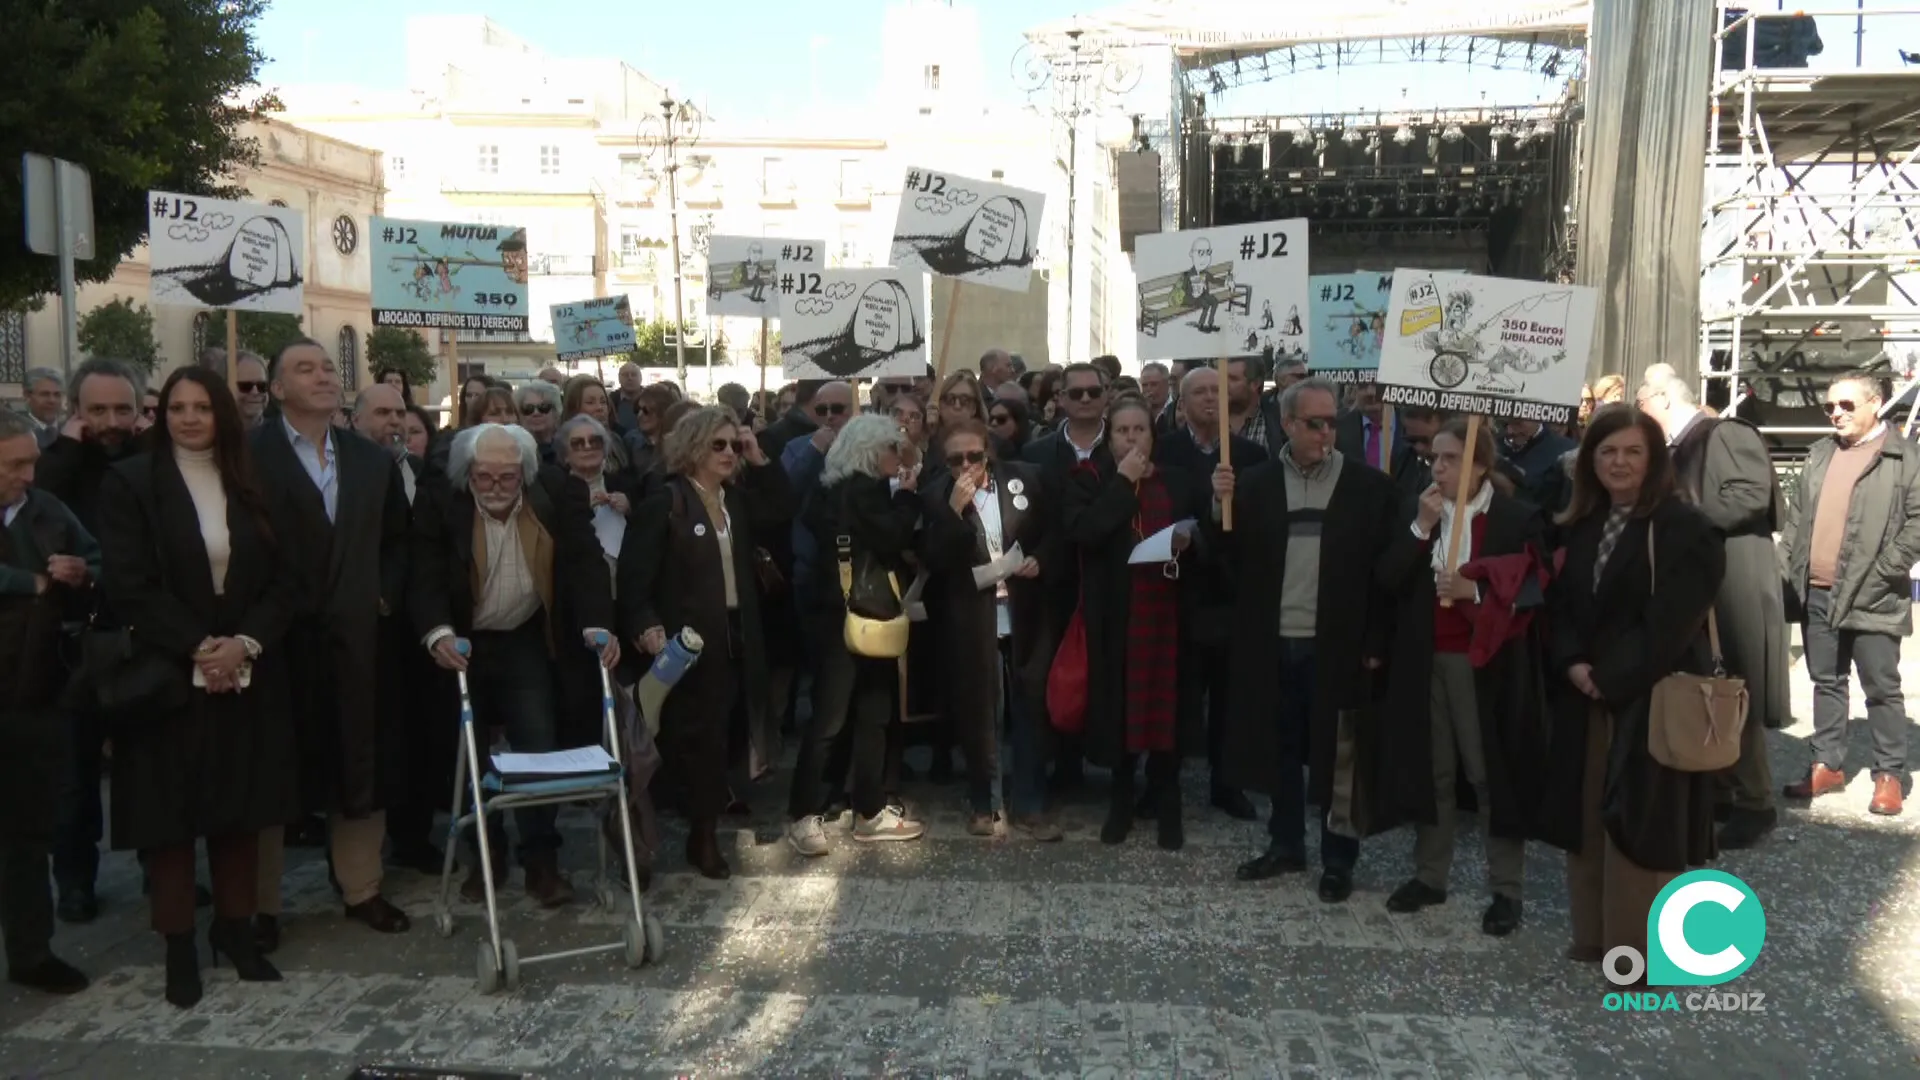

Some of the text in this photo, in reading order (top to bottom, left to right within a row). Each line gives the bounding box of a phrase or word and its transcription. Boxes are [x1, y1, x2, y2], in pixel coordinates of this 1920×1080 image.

[906, 171, 946, 196] #J2
[153, 197, 198, 221] #J2
[382, 226, 418, 244] #J2
[440, 224, 498, 241] MUTUA
[781, 245, 813, 262] #J2
[1240, 232, 1288, 260] #J2
[780, 273, 822, 294] #J2
[1411, 284, 1434, 300] #J2
[474, 292, 517, 307] 350
[1321, 284, 1355, 302] #J2
[378, 311, 523, 330] ABOGADO, DEFIENDE TUS DERECHOS
[1502, 319, 1563, 335] 350 Euros
[1500, 331, 1563, 346] JUBILACIÓN
[1382, 385, 1570, 424] ABOGADO, DEFIENDE TUS DERECHOS
